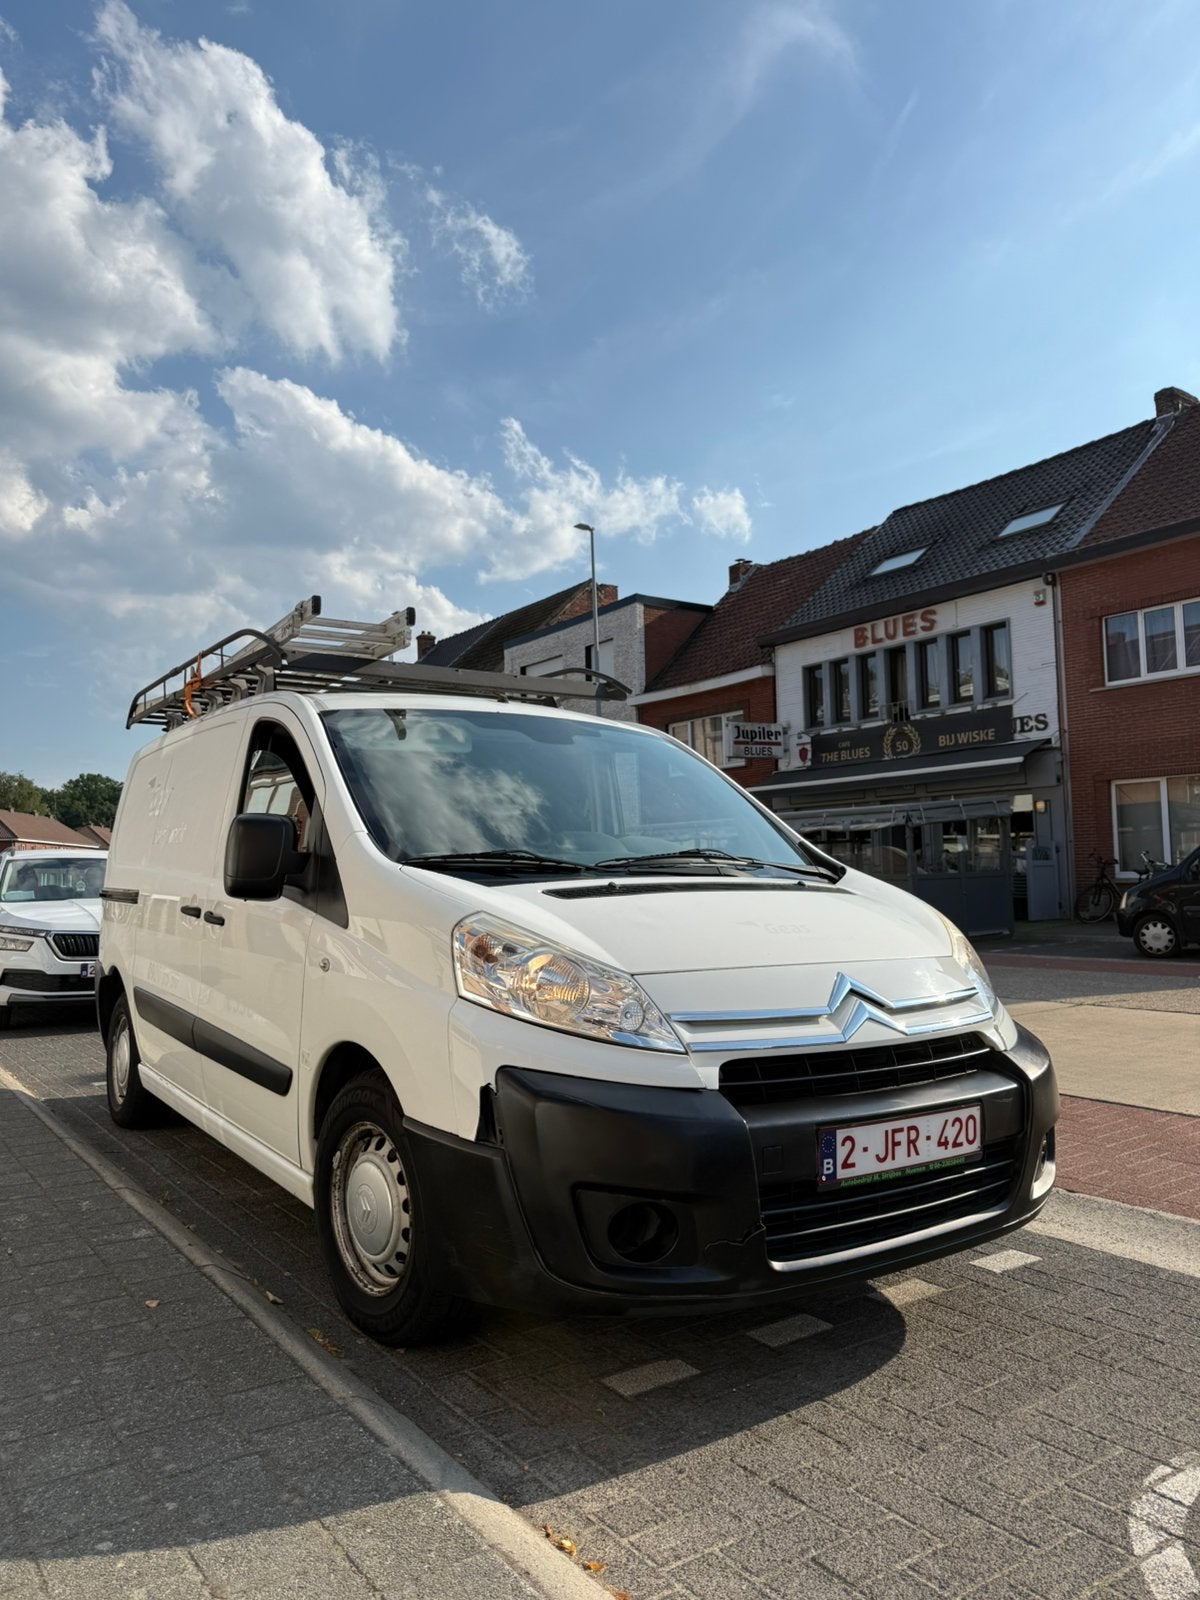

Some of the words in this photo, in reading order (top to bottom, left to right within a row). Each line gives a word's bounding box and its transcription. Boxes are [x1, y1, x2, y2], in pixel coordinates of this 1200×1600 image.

[853, 608, 937, 649] BLUES
[734, 725, 782, 742] Jupiler
[938, 733, 955, 747] BIJ
[955, 727, 996, 744] WISKE
[743, 746, 774, 756] BLUES
[895, 740, 909, 752] 50
[821, 750, 839, 764] THE
[840, 746, 871, 761] BLUES
[840, 1113, 977, 1170] 2-JFR-420
[823, 1158, 834, 1175] B
